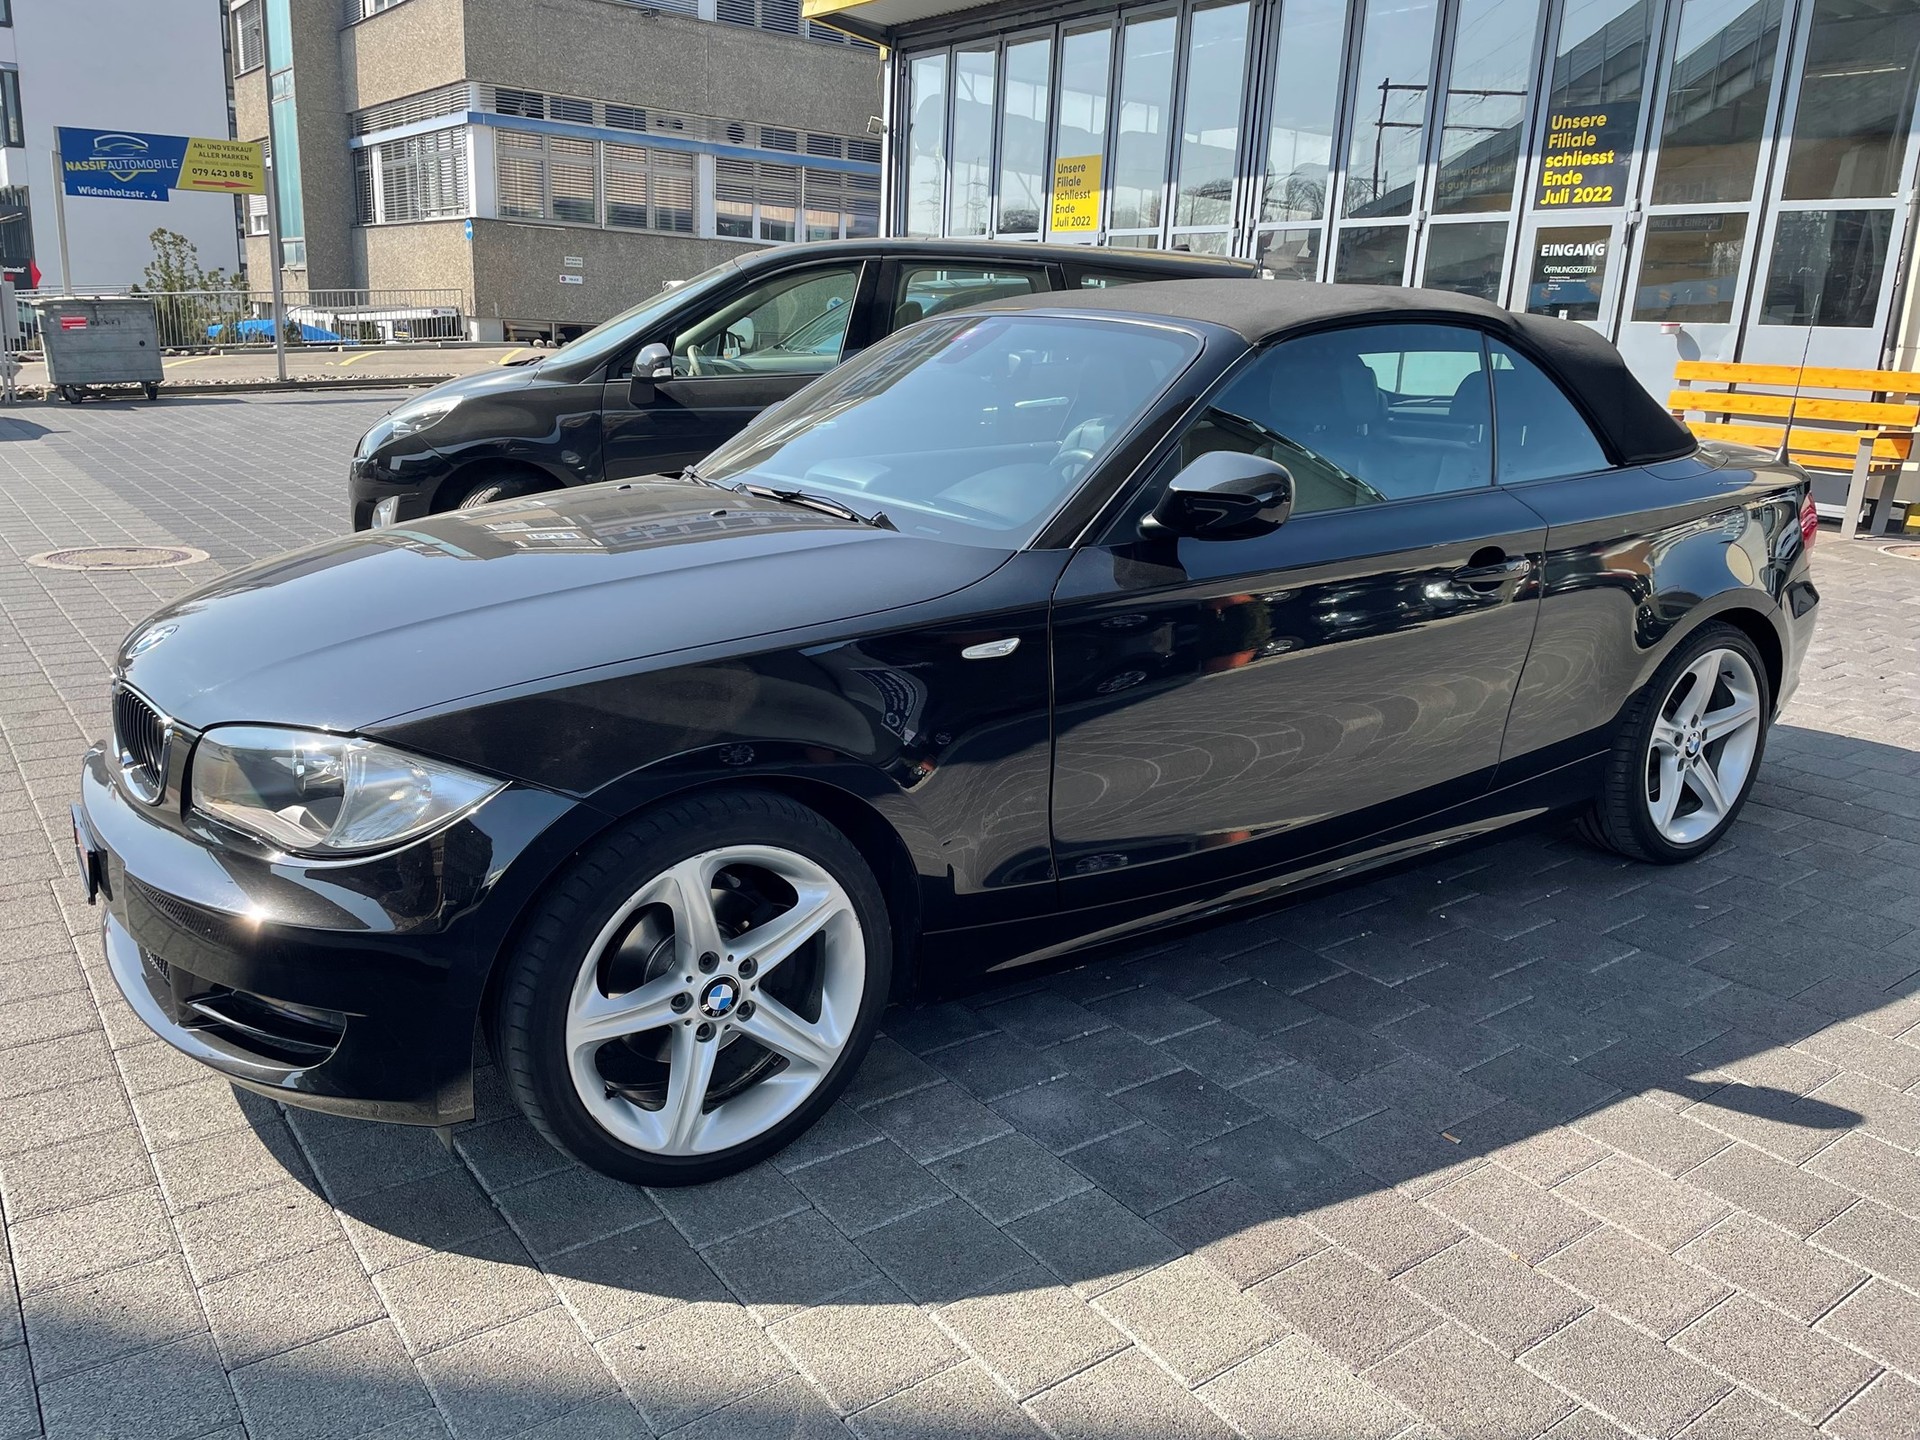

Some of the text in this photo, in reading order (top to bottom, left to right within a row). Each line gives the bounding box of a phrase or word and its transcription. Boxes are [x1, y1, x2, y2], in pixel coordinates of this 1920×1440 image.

[1552, 114, 1607, 130] Unsere
[1548, 131, 1596, 149] Filiale
[222, 145, 253, 153] VERKAUF
[221, 153, 250, 161] MARKEN
[1545, 150, 1615, 168] schliesst
[192, 168, 253, 179] 079 423 08 85
[1058, 164, 1086, 174] Unsere
[1057, 176, 1081, 187] Filiale
[1542, 170, 1583, 186] Ende
[77, 186, 158, 199] Widenholzstr. 4
[1056, 190, 1090, 200] schliesst
[1540, 186, 1613, 205] Juli 2022
[1055, 203, 1075, 214] Ende
[1055, 216, 1090, 227] Juli 2022
[1541, 244, 1606, 257] EINGANG
[1543, 265, 1597, 273] ÖFFNUNGSZEITEN
